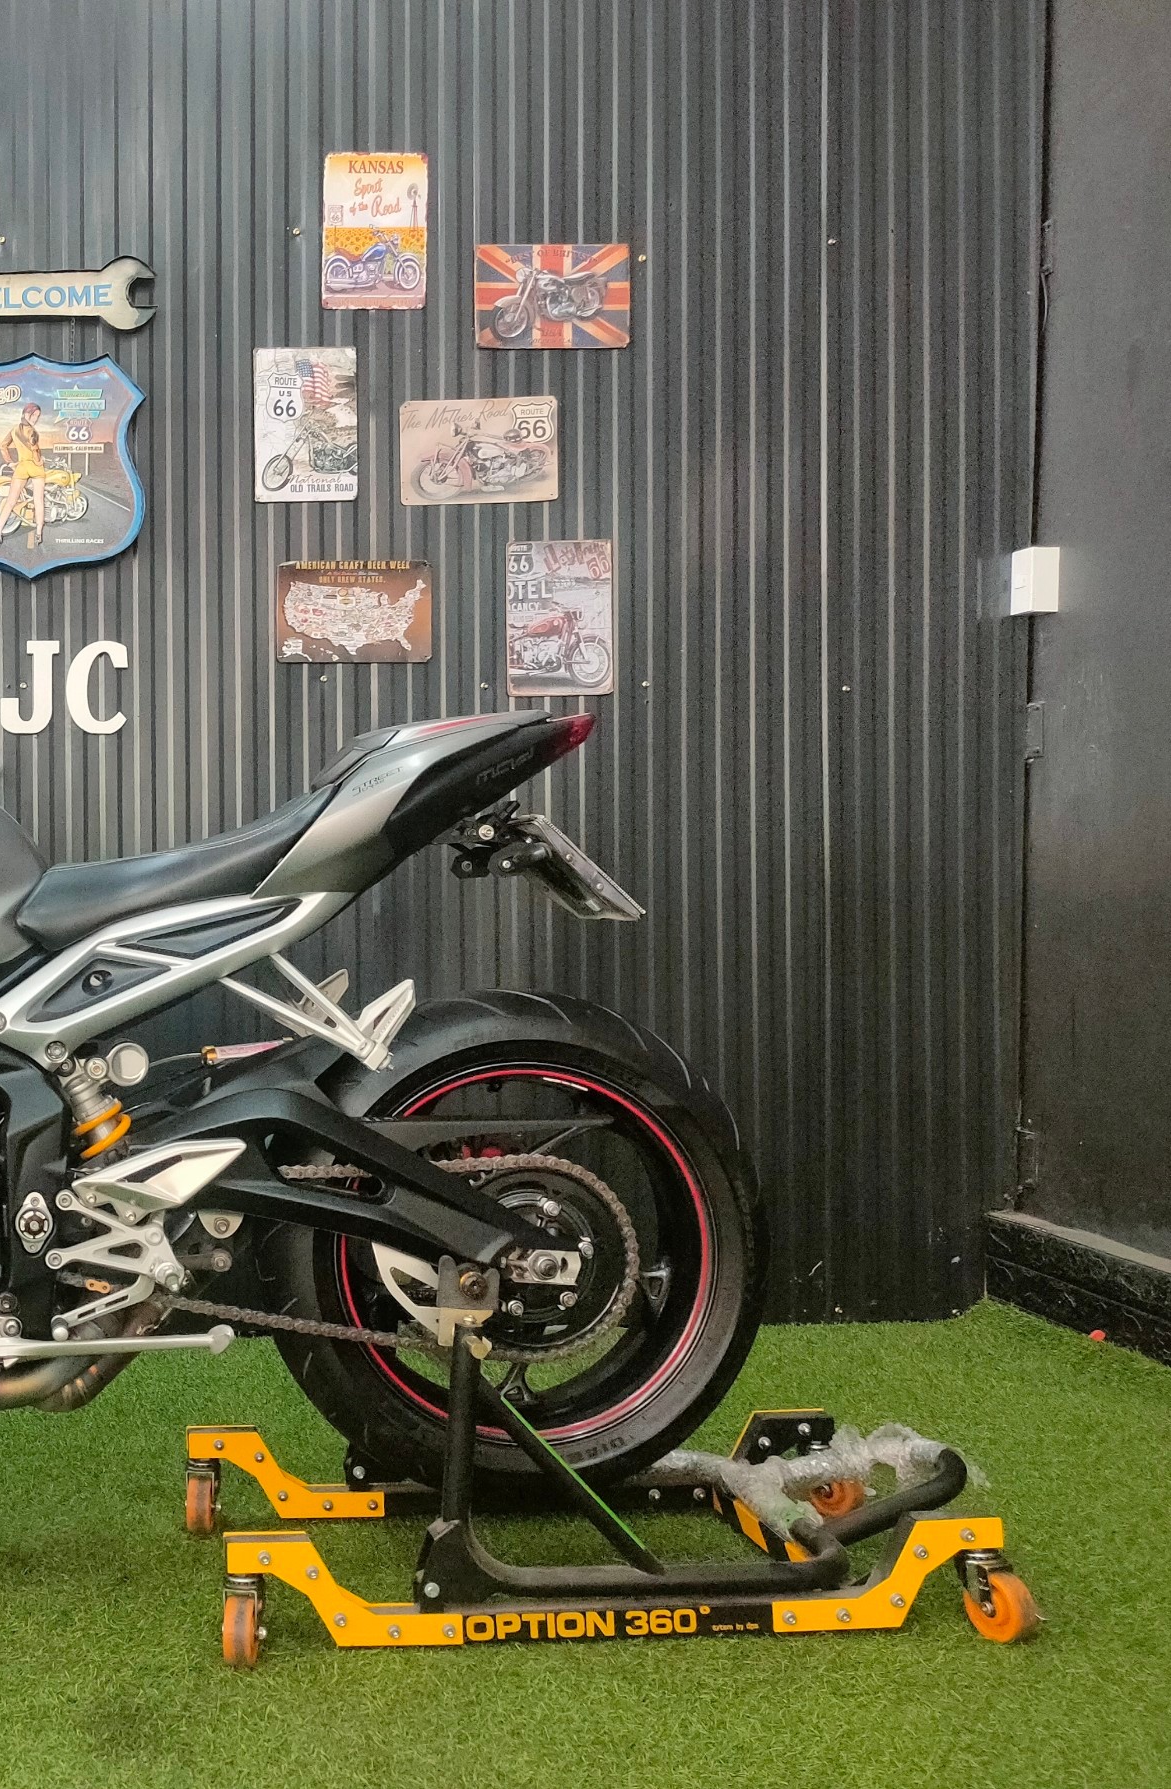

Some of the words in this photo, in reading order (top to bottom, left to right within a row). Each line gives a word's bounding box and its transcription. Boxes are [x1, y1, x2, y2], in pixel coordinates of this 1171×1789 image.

[348, 160, 404, 174] KANSAS
[353, 178, 383, 198] Spirit
[349, 202, 357, 217] of
[371, 195, 402, 218] Road
[274, 376, 297, 387] ROUTE
[56, 401, 102, 409] HIGHWAY
[273, 399, 297, 418] 66
[401, 409, 421, 432] The
[425, 405, 474, 430] Mother
[479, 400, 513, 423] Road
[68, 426, 89, 440] 66
[517, 419, 547, 439] 66
[287, 473, 342, 484] National
[290, 484, 303, 493] OLD
[307, 484, 331, 493] TRAILS
[335, 483, 354, 492] ROAD
[295, 560, 336, 570] AMERICAN
[339, 560, 364, 570] CRAFT
[367, 560, 387, 570] BEER
[389, 560, 410, 570] WEEK
[508, 555, 529, 573] 66
[587, 552, 611, 579] 66
[465, 1610, 615, 1642] OPTION
